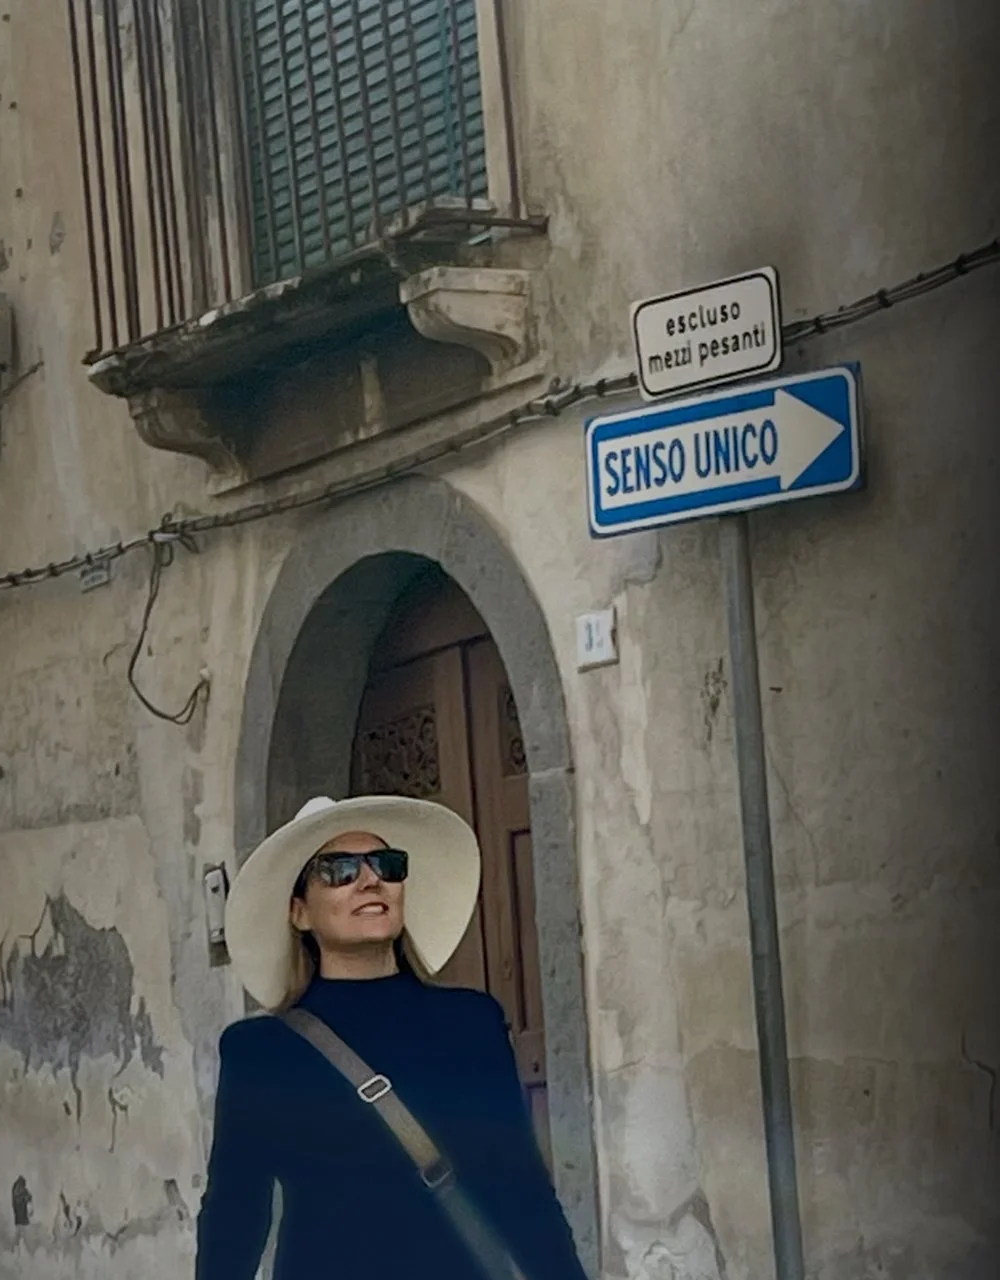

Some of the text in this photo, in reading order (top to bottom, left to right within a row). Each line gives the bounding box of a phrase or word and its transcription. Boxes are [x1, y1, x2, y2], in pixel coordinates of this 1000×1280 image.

[665, 301, 741, 337] escluso
[648, 324, 766, 375] mezzi pesanti
[604, 419, 778, 497] SENSO UNICO
